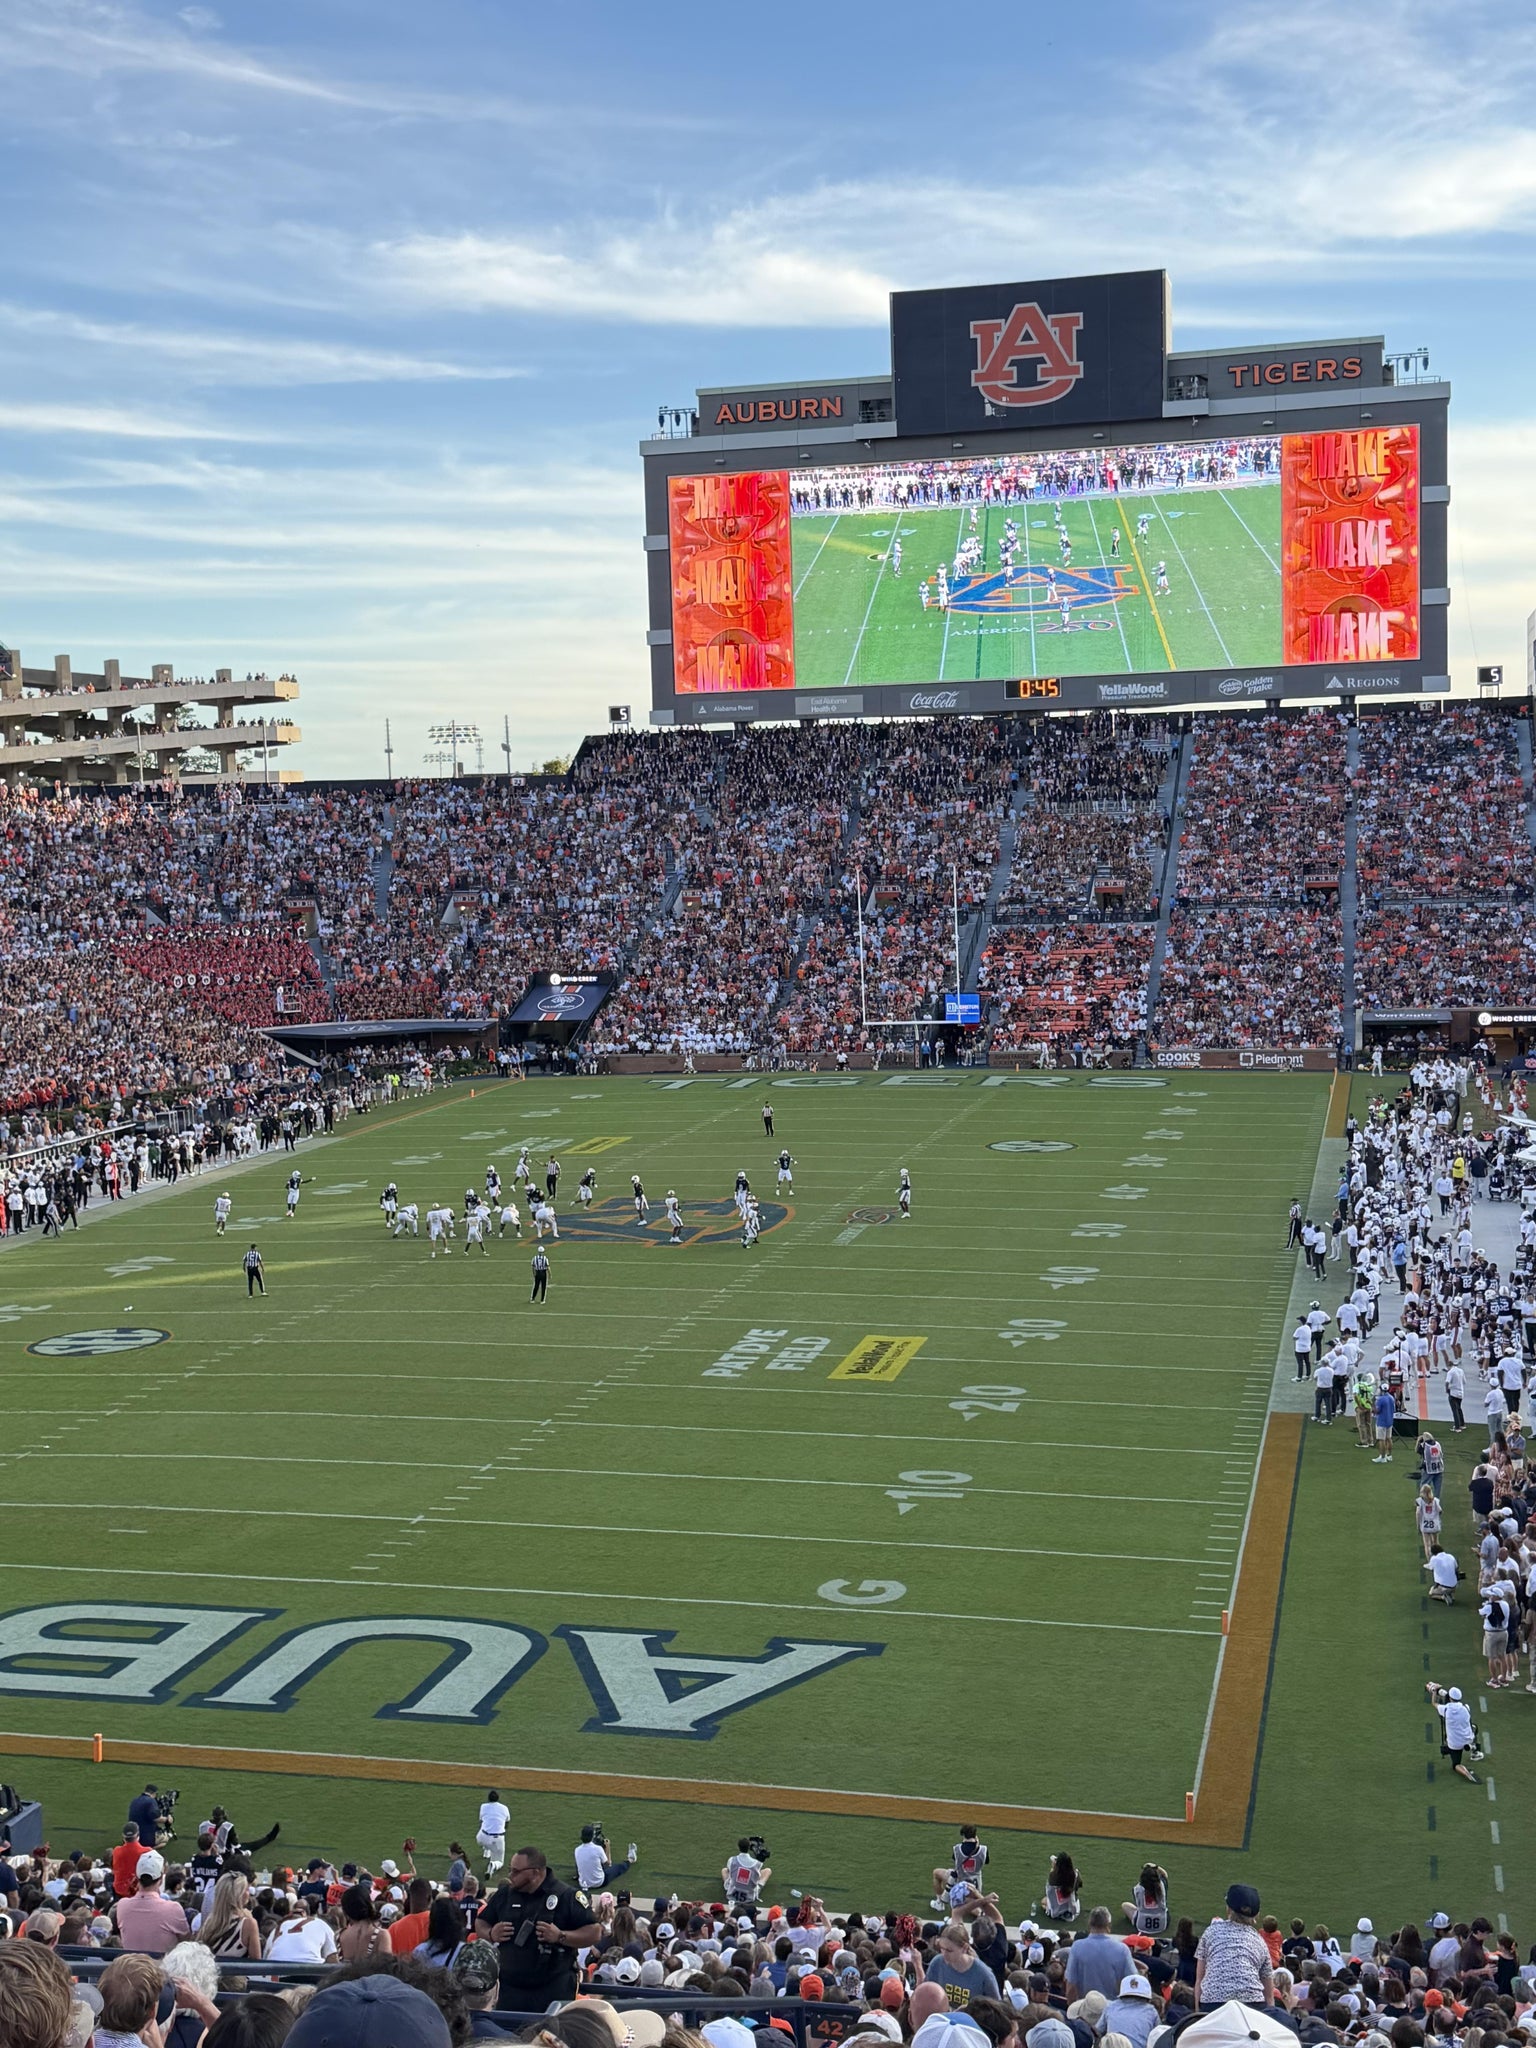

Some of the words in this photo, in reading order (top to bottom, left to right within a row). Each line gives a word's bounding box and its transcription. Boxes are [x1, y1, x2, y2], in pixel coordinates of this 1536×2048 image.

[1228, 357, 1363, 388] TIGERS
[715, 396, 844, 425] AUBURN
[1312, 432, 1391, 480] MAKE
[1311, 520, 1393, 568] MAKE
[950, 626, 1031, 637] AMERICA
[1309, 612, 1395, 662] MAKE
[1019, 678, 1059, 699] 0:45
[1243, 676, 1273, 688] Golden
[1247, 683, 1273, 695] Flake
[1347, 677, 1400, 688] REGIONS
[713, 705, 737, 713] Alabama
[737, 704, 754, 712] Power
[910, 690, 960, 710] Coca-Cola
[1491, 1015, 1512, 1023] WIND
[1157, 1052, 1201, 1062] COOK'S
[647, 1074, 1169, 1090] TIGERS
[1039, 1265, 1100, 1285] 40
[998, 1318, 1069, 1342] 30
[730, 1328, 789, 1353] DYE
[765, 1336, 832, 1371] FIELD
[701, 1353, 762, 1379] PAT
[948, 1384, 1028, 1413] 20
[884, 1469, 974, 1500] 10
[1423, 1520, 1435, 1529] 28
[817, 1578, 908, 1605] G
[465, 1909, 472, 1930] 1
[1145, 1917, 1160, 1929] 86
[1321, 1940, 1341, 1957] 44
[817, 2019, 844, 2037] 42
